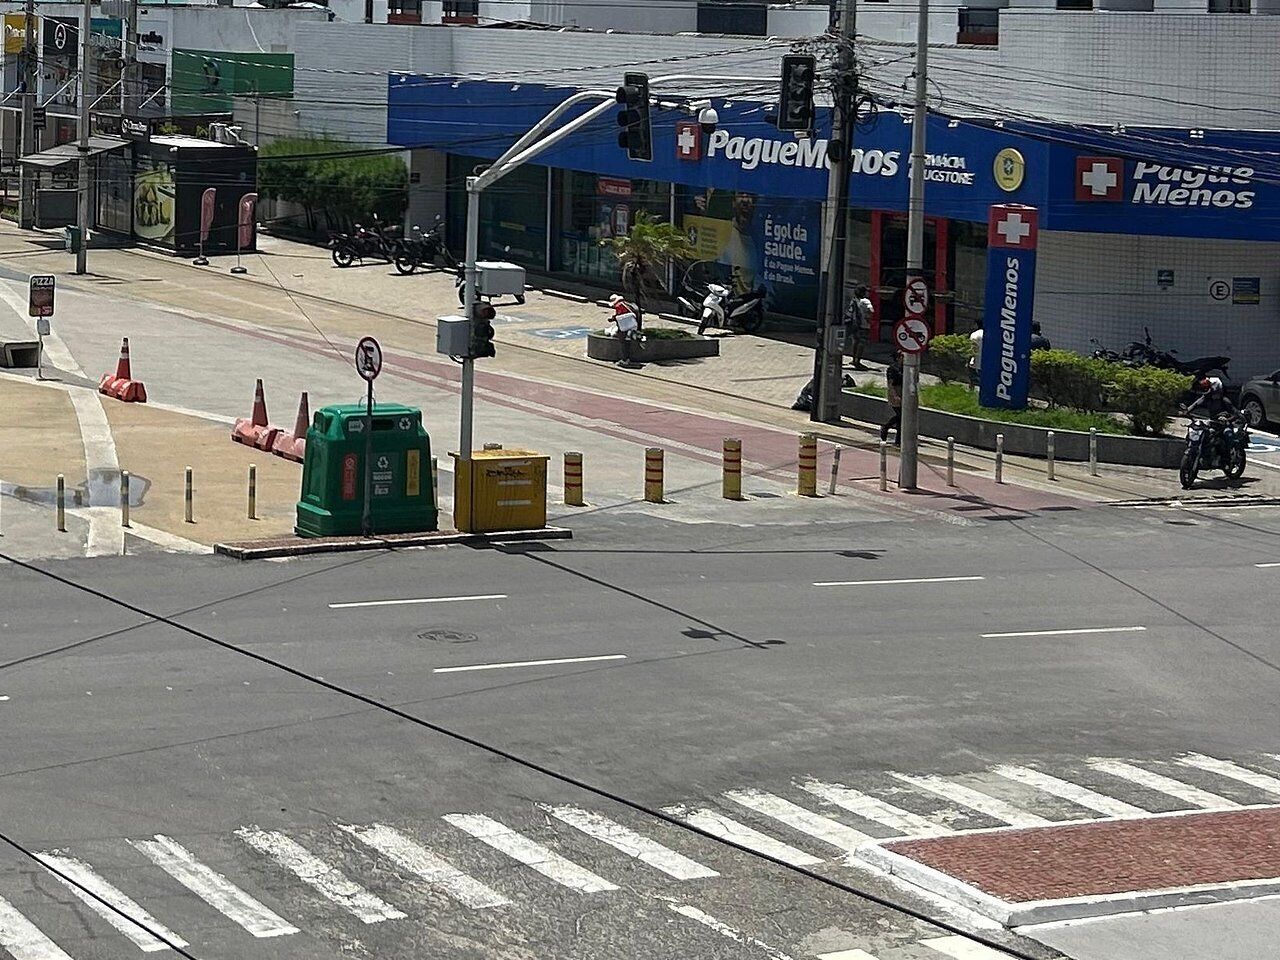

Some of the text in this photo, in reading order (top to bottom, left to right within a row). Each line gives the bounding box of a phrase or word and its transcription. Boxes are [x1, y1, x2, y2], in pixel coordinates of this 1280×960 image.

[706, 129, 901, 177] PagueMnos
[1131, 182, 1256, 209] Menos
[764, 214, 808, 242] É gol da
[1215, 285, 1225, 297] E
[996, 256, 1021, 402] PagueMenos
